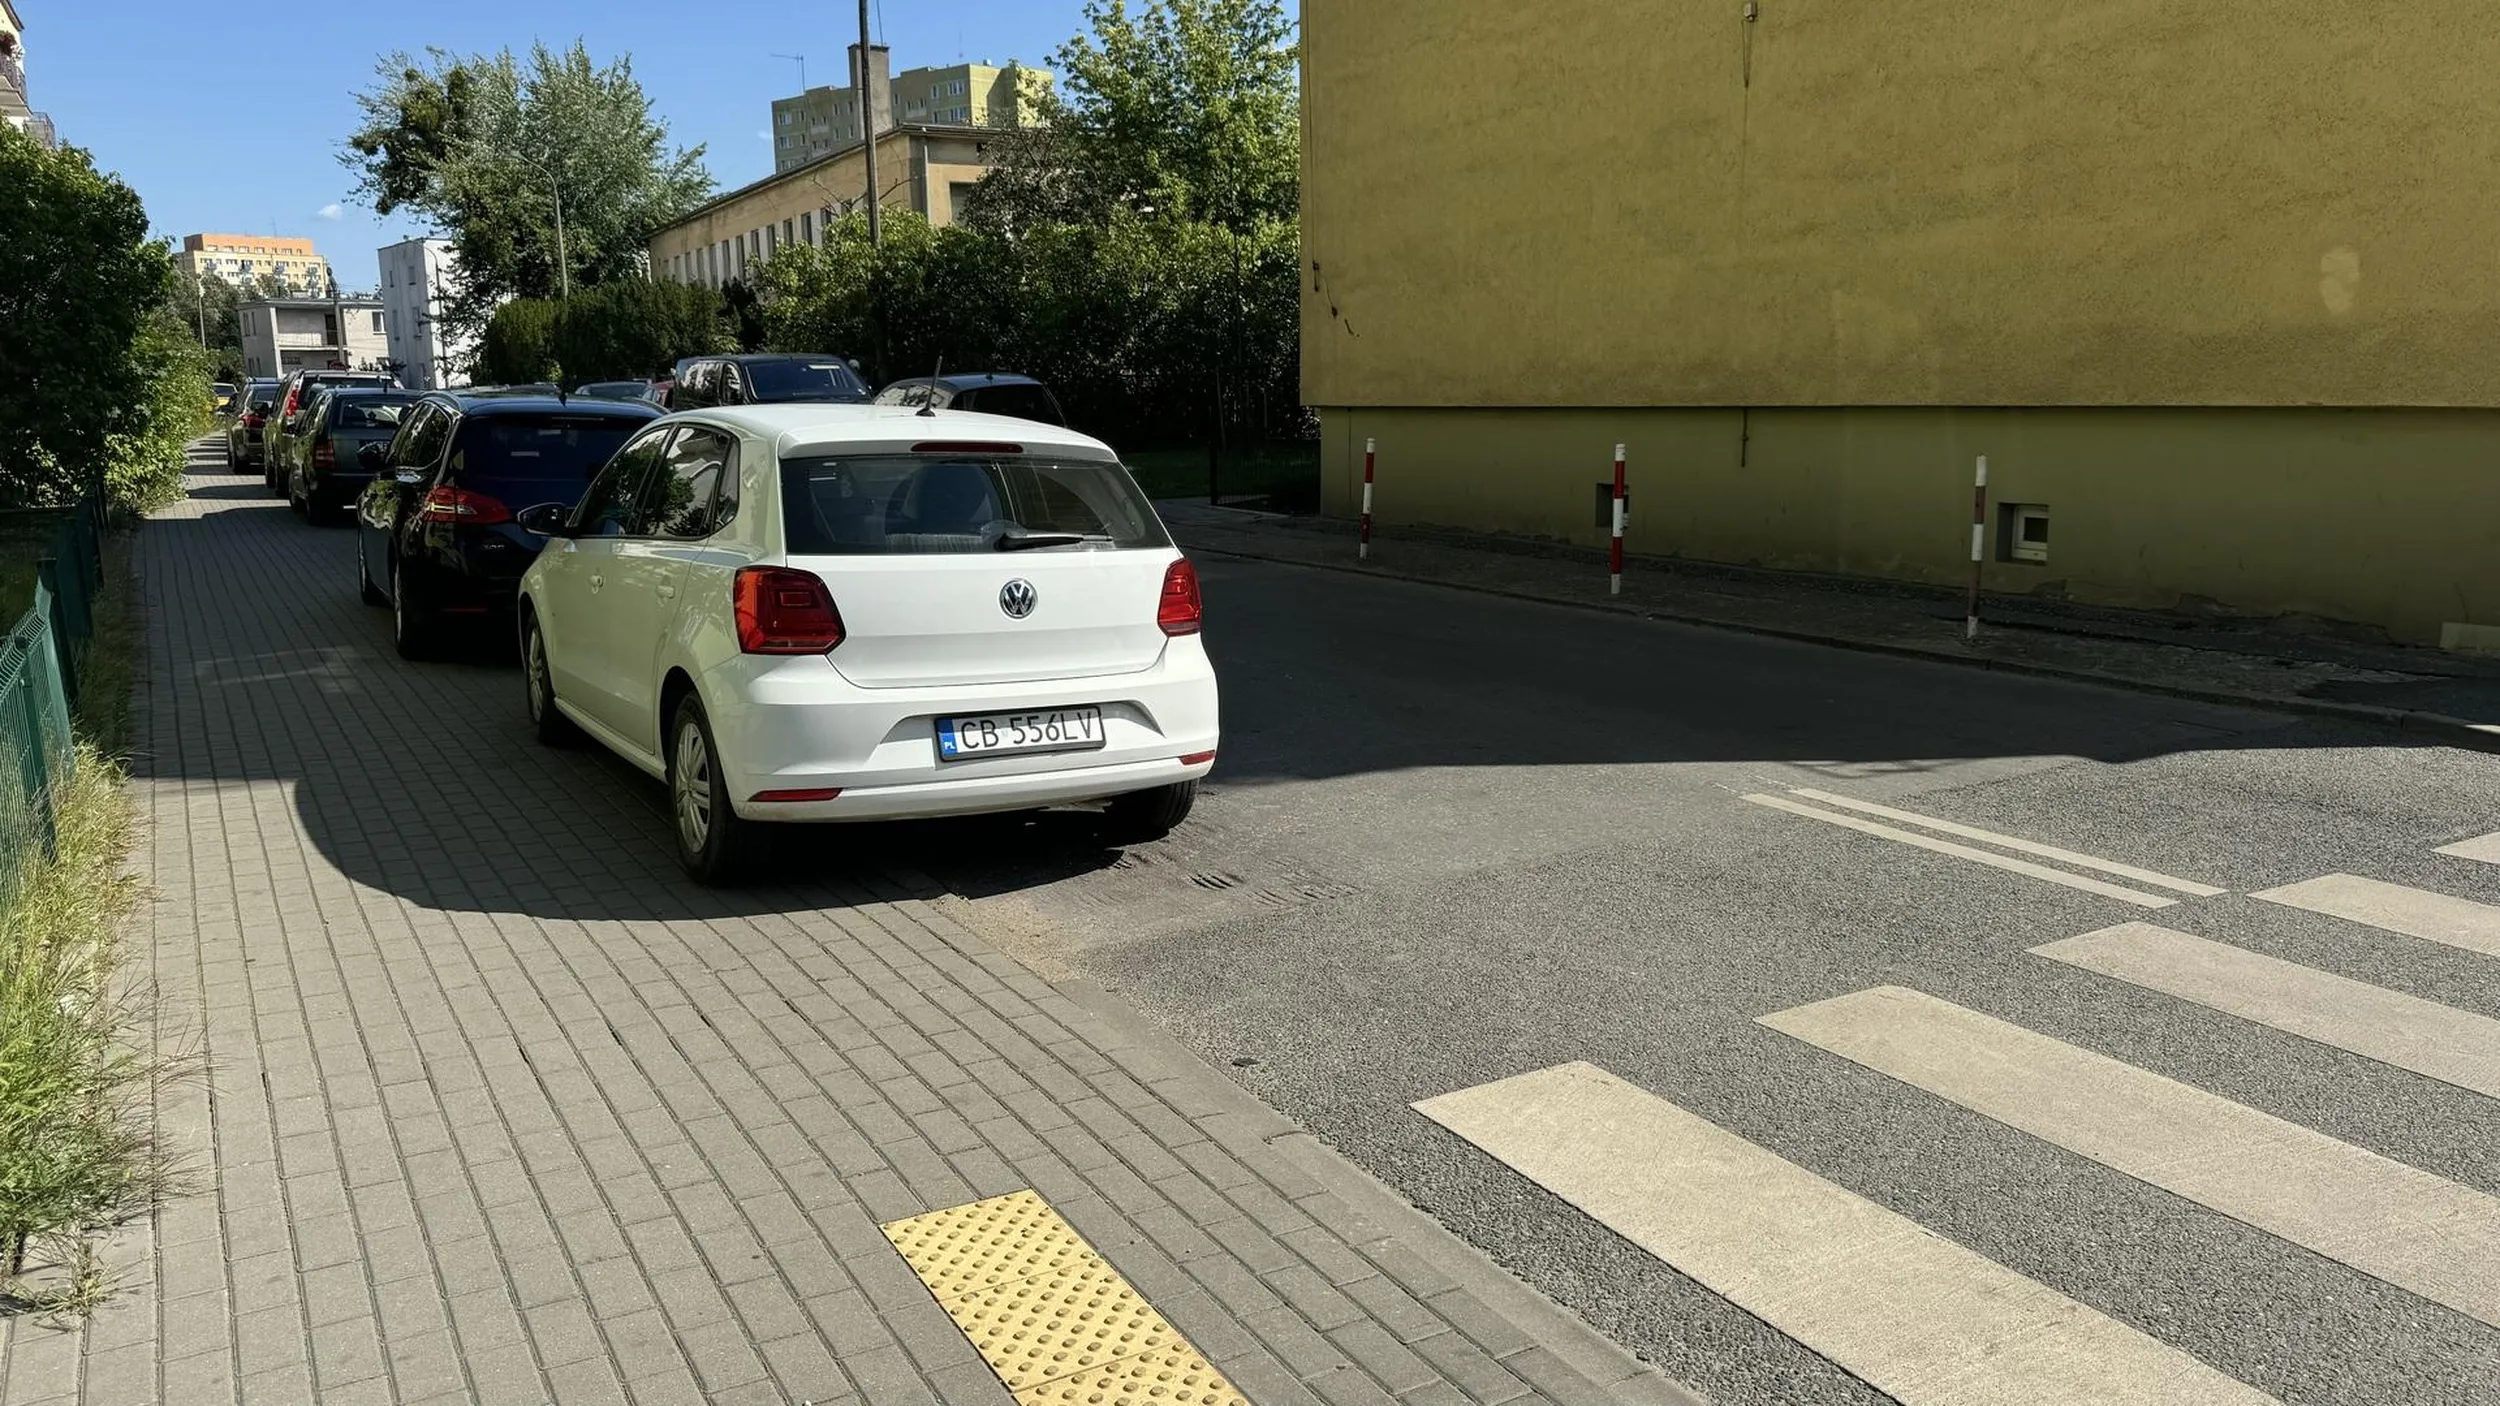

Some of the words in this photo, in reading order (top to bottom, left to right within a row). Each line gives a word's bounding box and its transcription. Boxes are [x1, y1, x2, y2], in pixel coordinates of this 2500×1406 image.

[961, 719, 999, 749] CB
[1009, 711, 1092, 744] 556LV
[944, 741, 955, 750] PL
